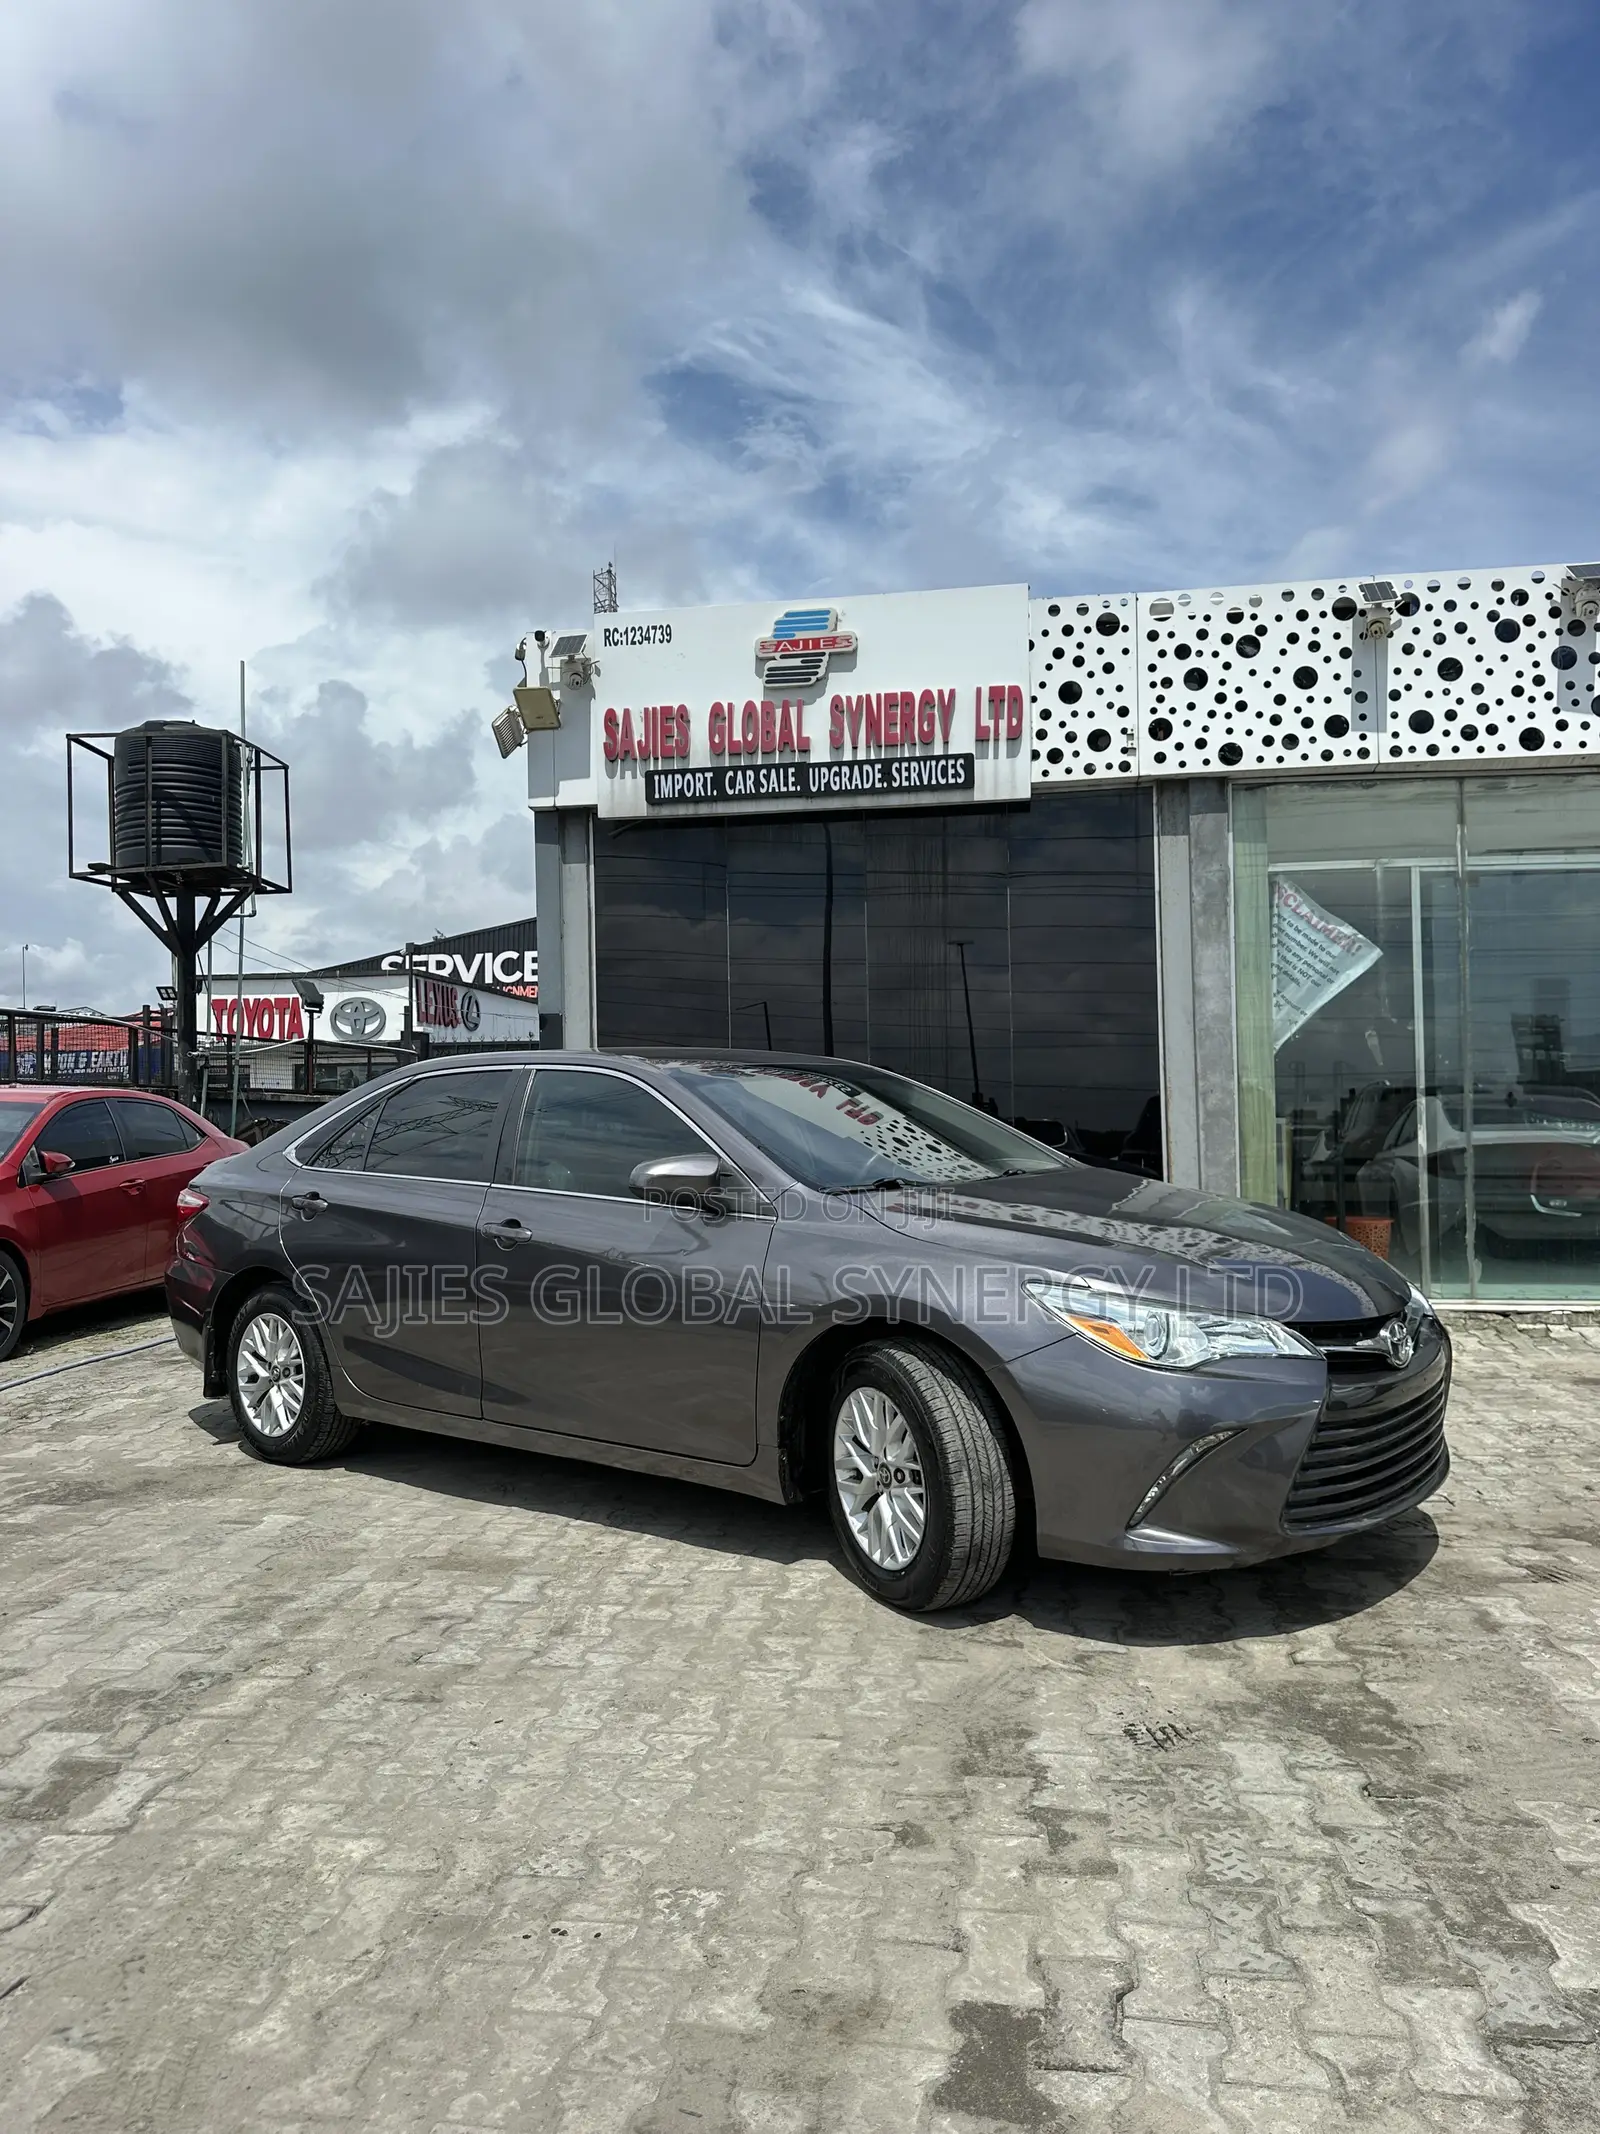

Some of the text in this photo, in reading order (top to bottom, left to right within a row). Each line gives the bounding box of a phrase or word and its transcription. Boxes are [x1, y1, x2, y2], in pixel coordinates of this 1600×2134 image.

[603, 624, 672, 647] RC:1234739
[759, 634, 853, 653] SAJIES
[603, 685, 1024, 762] SAJIES GLOBAL SYNERGY LTD
[653, 758, 966, 799] IMPORT. CAR SALE. UPGRADE. SERVICES
[1293, 924, 1303, 933] be
[1301, 930, 1319, 946] made
[1318, 943, 1326, 952] to
[1325, 949, 1337, 959] our
[1291, 951, 1303, 962] any
[1302, 958, 1328, 980] personal
[1297, 968, 1311, 980] NOT
[1307, 949, 1318, 959] We
[1318, 956, 1329, 967] will
[1328, 965, 1339, 975] not
[211, 997, 304, 1042] TOYOTA
